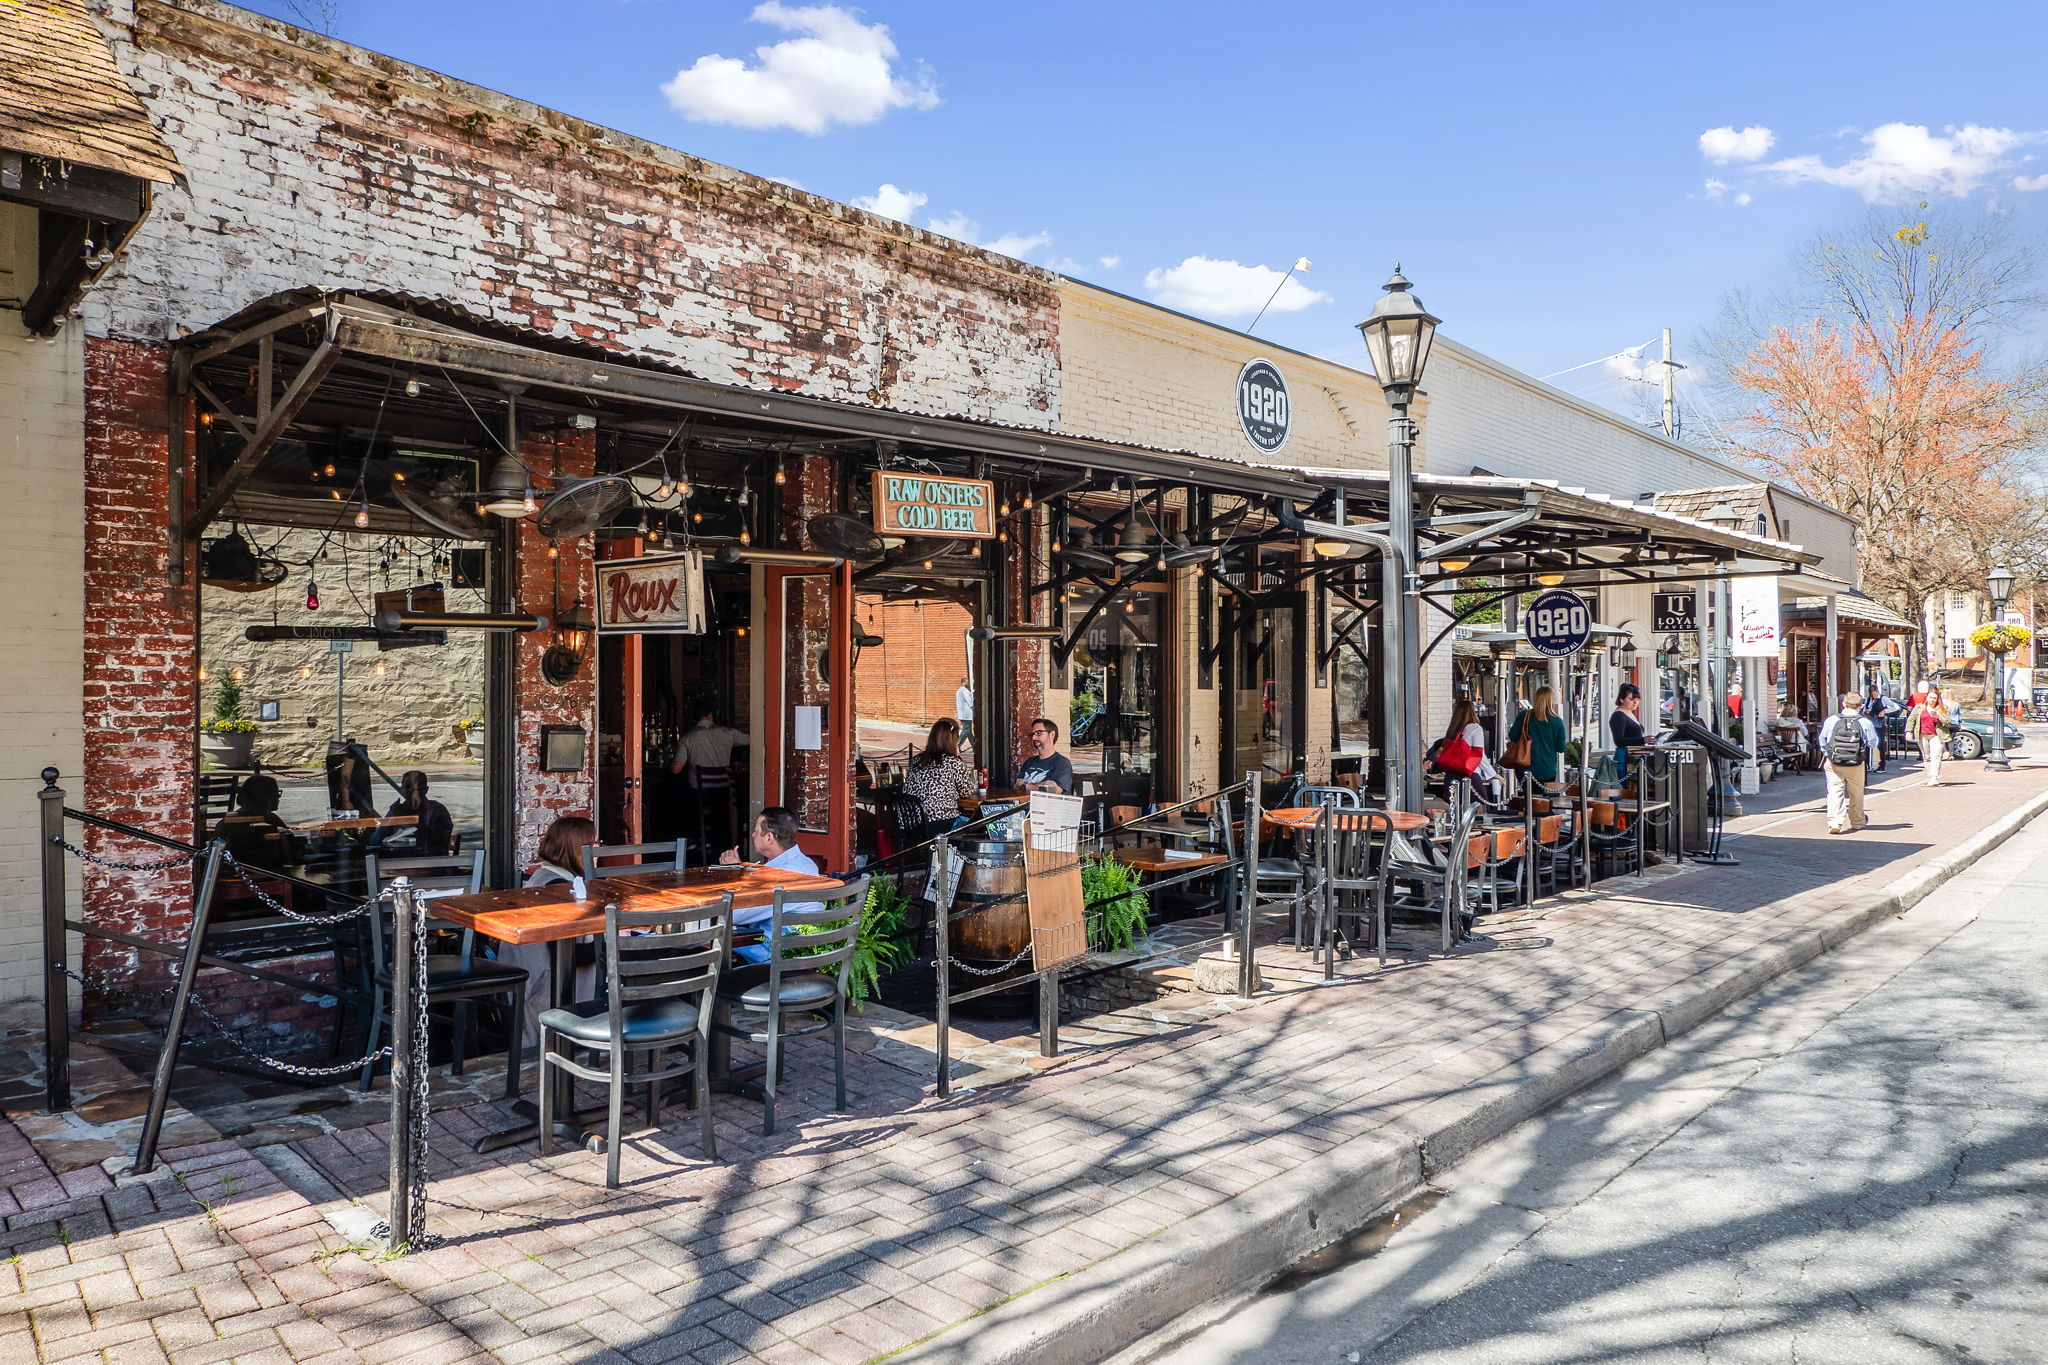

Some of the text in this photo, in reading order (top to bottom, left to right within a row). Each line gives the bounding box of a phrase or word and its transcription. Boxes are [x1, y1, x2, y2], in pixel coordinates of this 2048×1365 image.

[1242, 381, 1286, 427] 1920
[1253, 430, 1267, 445] TAVERN
[1268, 438, 1276, 446] FOR
[888, 479, 984, 507] RAW OYSTERS
[898, 505, 977, 531] COLD BEER
[608, 572, 680, 623] Roux
[1528, 606, 1586, 638] 1920
[1542, 646, 1560, 655] TAVERN
[1560, 646, 1570, 655] FOR
[1569, 641, 1579, 651] ALL
[1664, 749, 1694, 764] 920
